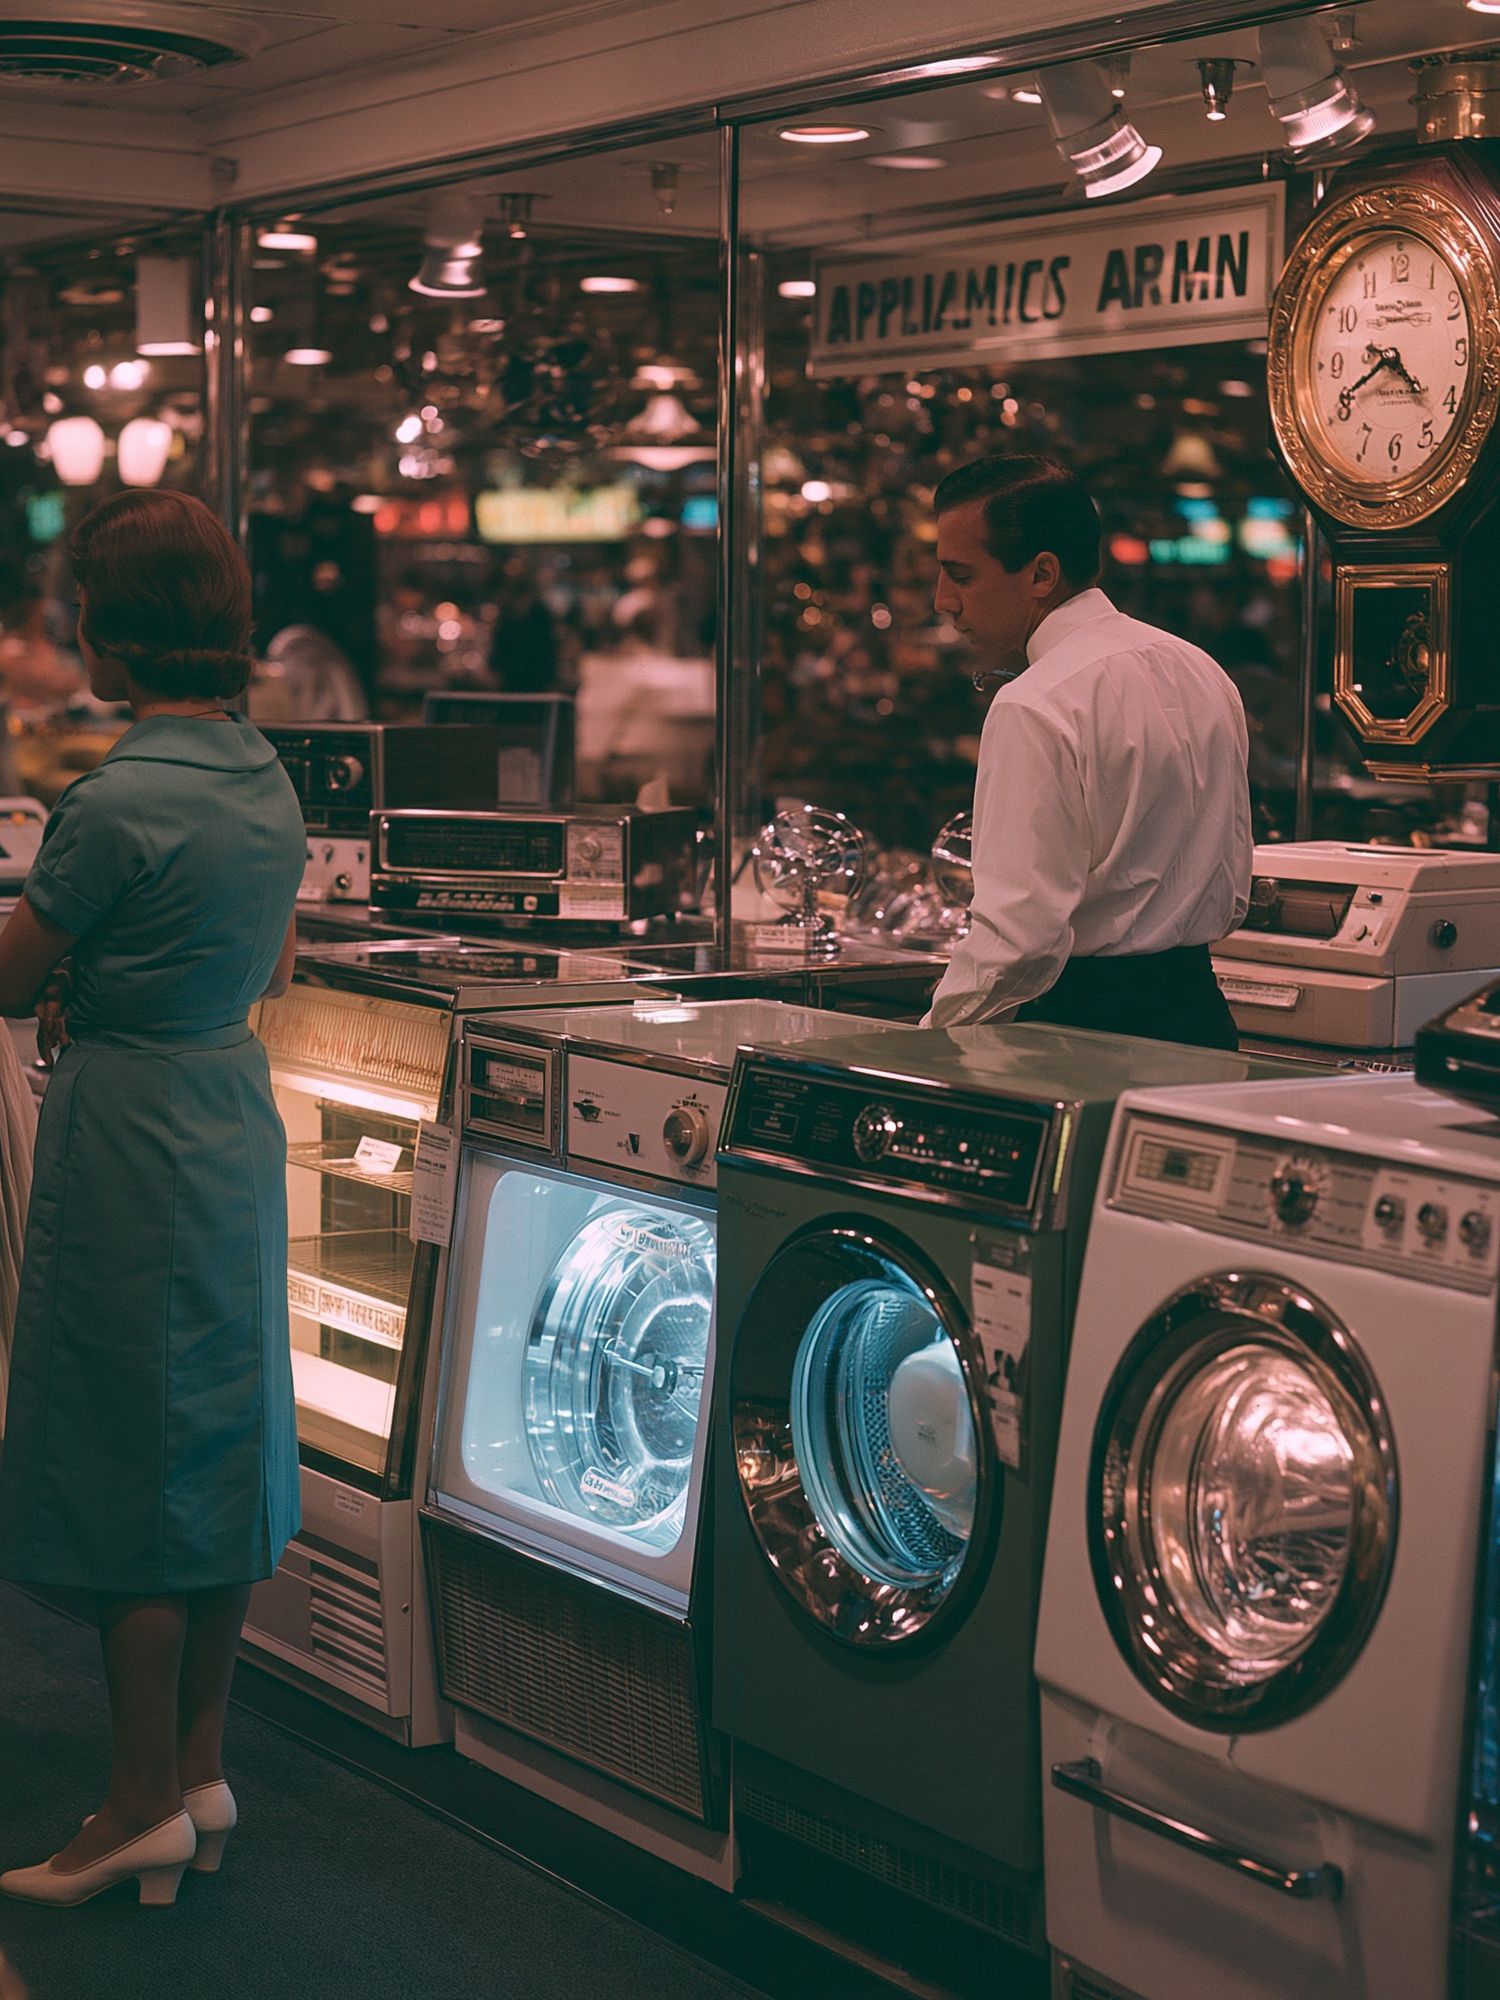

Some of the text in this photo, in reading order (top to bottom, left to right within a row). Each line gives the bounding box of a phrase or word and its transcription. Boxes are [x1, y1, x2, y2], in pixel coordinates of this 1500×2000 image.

[1390, 253, 1410, 284] 12
[1427, 263, 1435, 290] 1
[1362, 271, 1377, 299] 11
[1338, 304, 1358, 333] 10
[1447, 290, 1461, 321] 2
[1331, 352, 1344, 379] 9
[1454, 337, 1468, 367] 3
[1337, 388, 1351, 421] 8
[1442, 385, 1457, 415] 4
[1360, 422, 1373, 456] 7
[1388, 433, 1403, 461] 6
[1417, 419, 1434, 448] 5
